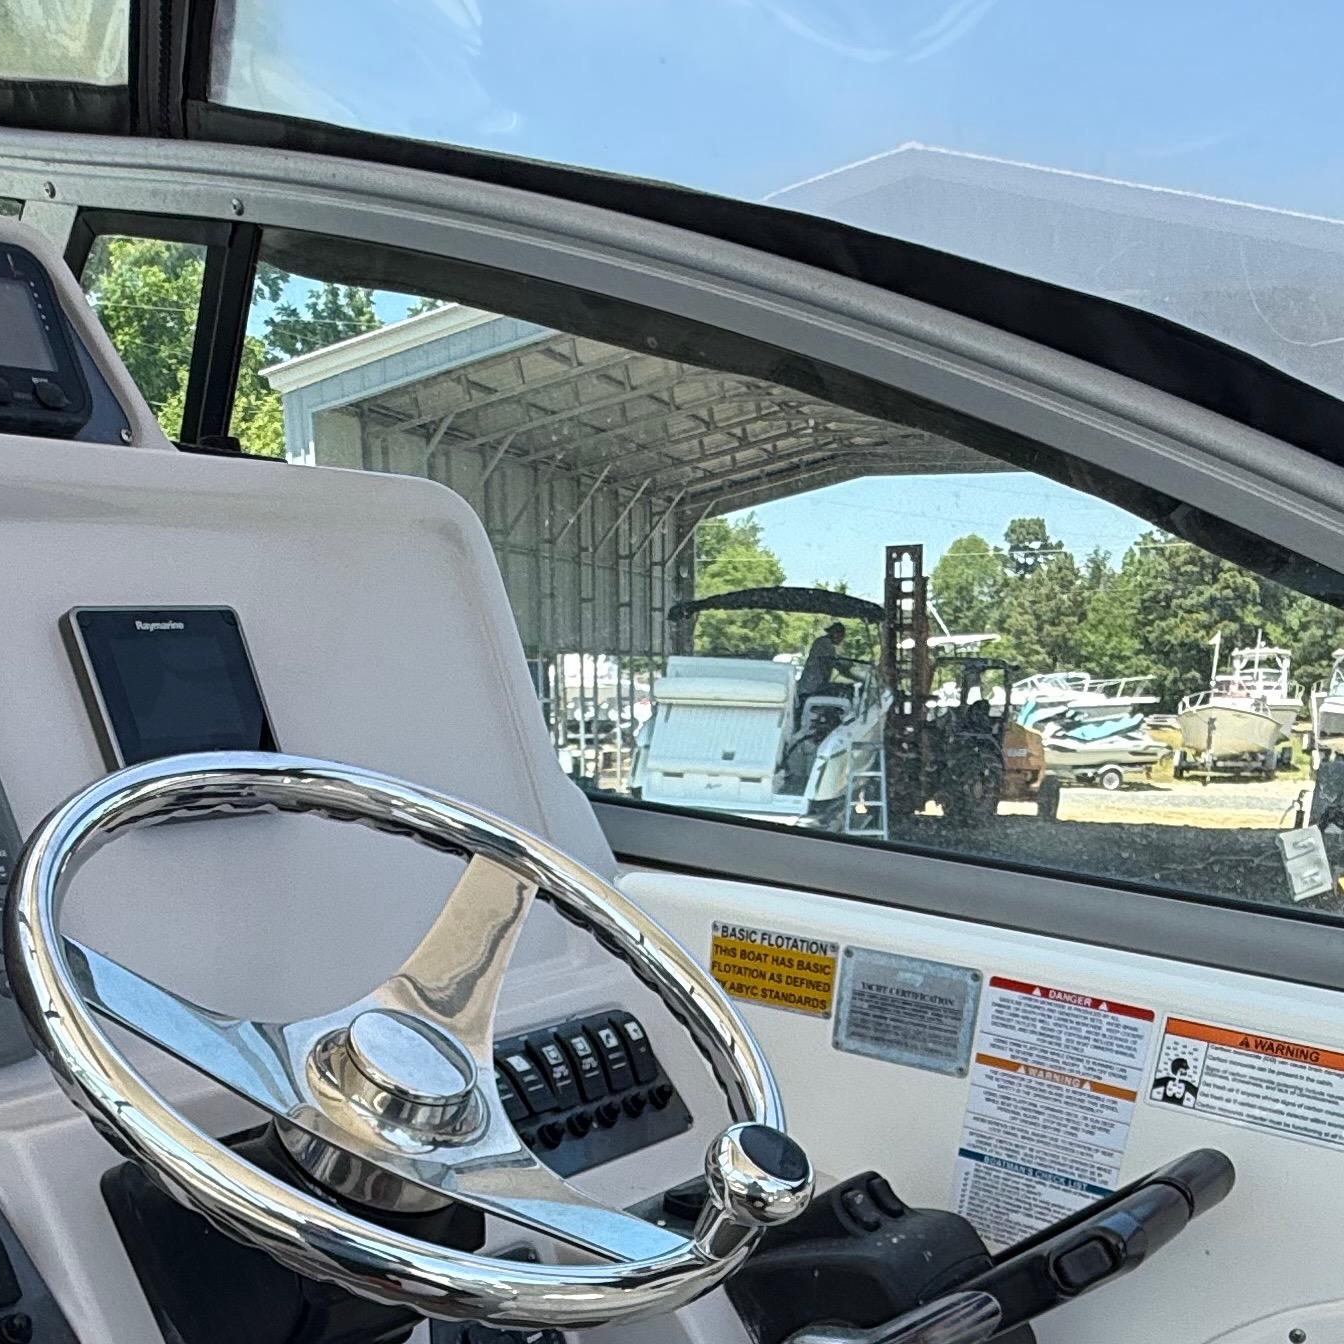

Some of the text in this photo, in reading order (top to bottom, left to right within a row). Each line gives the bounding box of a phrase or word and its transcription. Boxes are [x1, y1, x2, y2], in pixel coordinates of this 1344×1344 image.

[135, 620, 185, 632] Raymarine
[721, 925, 828, 956] BASIC FLOTATION
[714, 943, 831, 976] THIS BOAT HAS BASIC
[712, 960, 831, 993] FLOTATION AS DEFINED
[728, 982, 758, 997] ABYC
[761, 988, 827, 1010] STANDARDS
[1048, 989, 1092, 1007] DANGER
[1254, 1039, 1320, 1063] WARNING
[1028, 1065, 1081, 1088] WARNING
